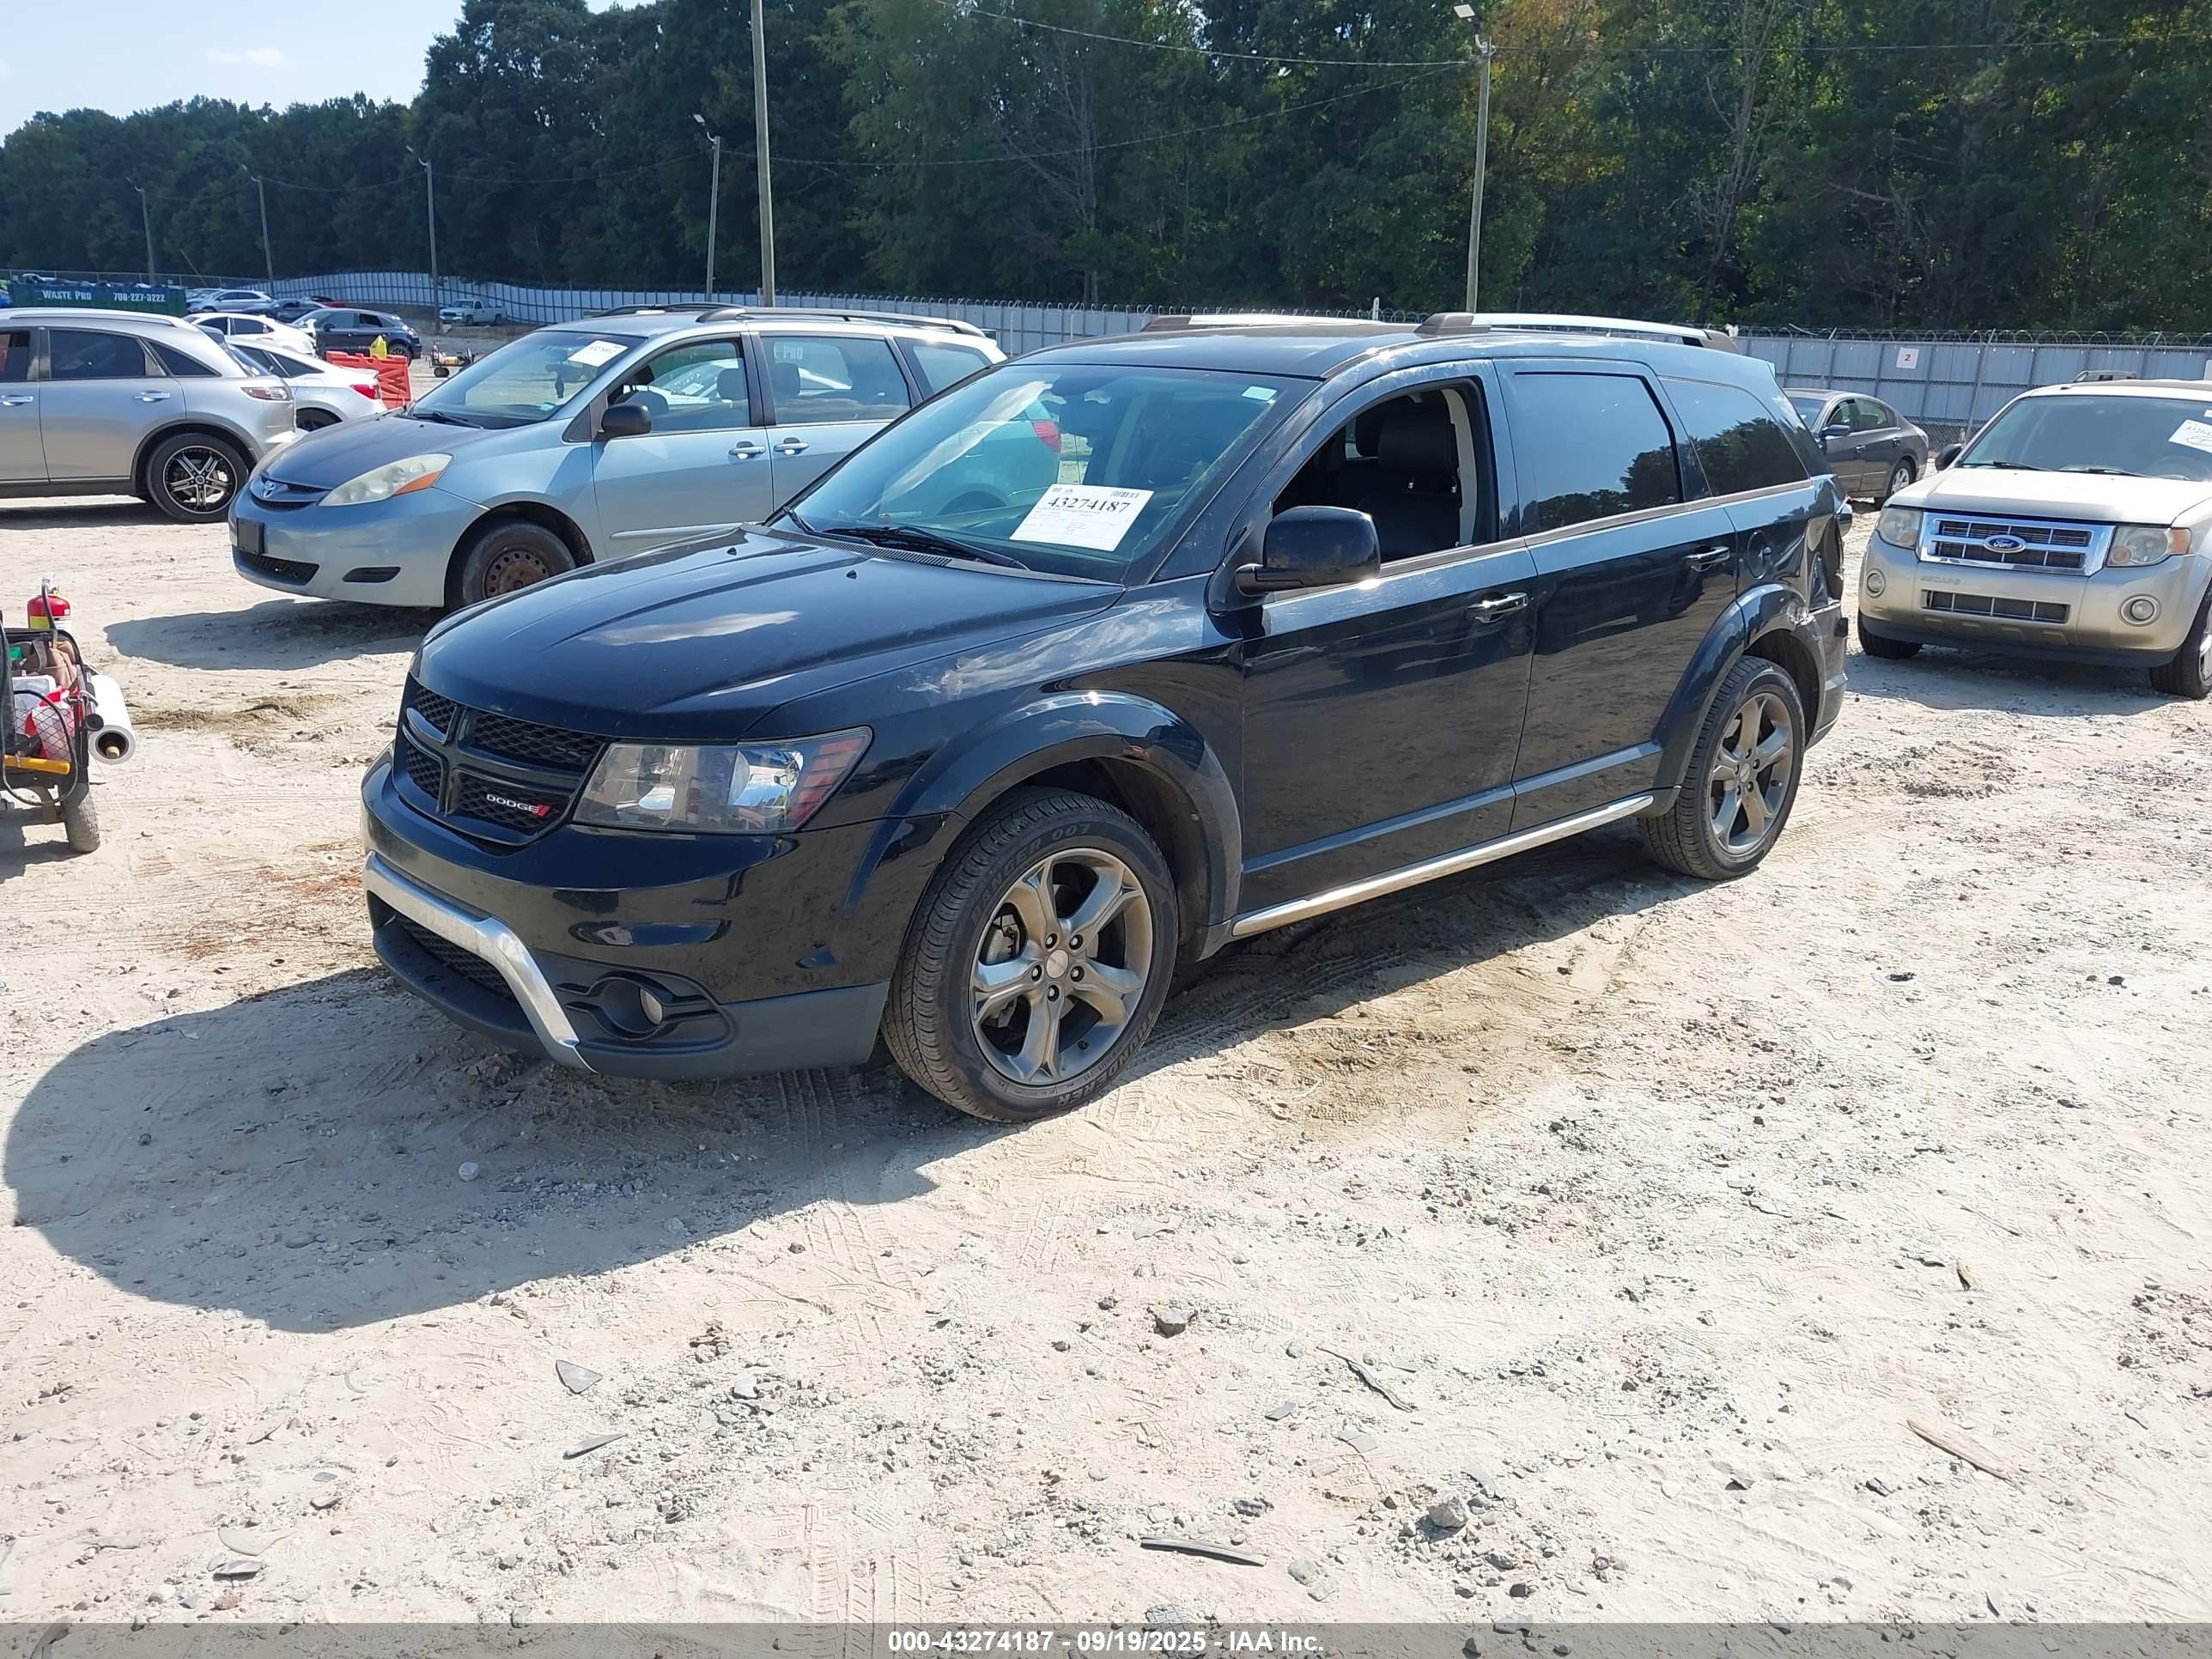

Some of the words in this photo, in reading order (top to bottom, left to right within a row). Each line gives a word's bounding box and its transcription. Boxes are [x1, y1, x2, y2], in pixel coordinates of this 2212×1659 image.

[1048, 496, 1132, 513] 43274187
[1992, 539, 2014, 549] Ford
[485, 793, 540, 813] DODGE
[1051, 823, 1091, 840] 007
